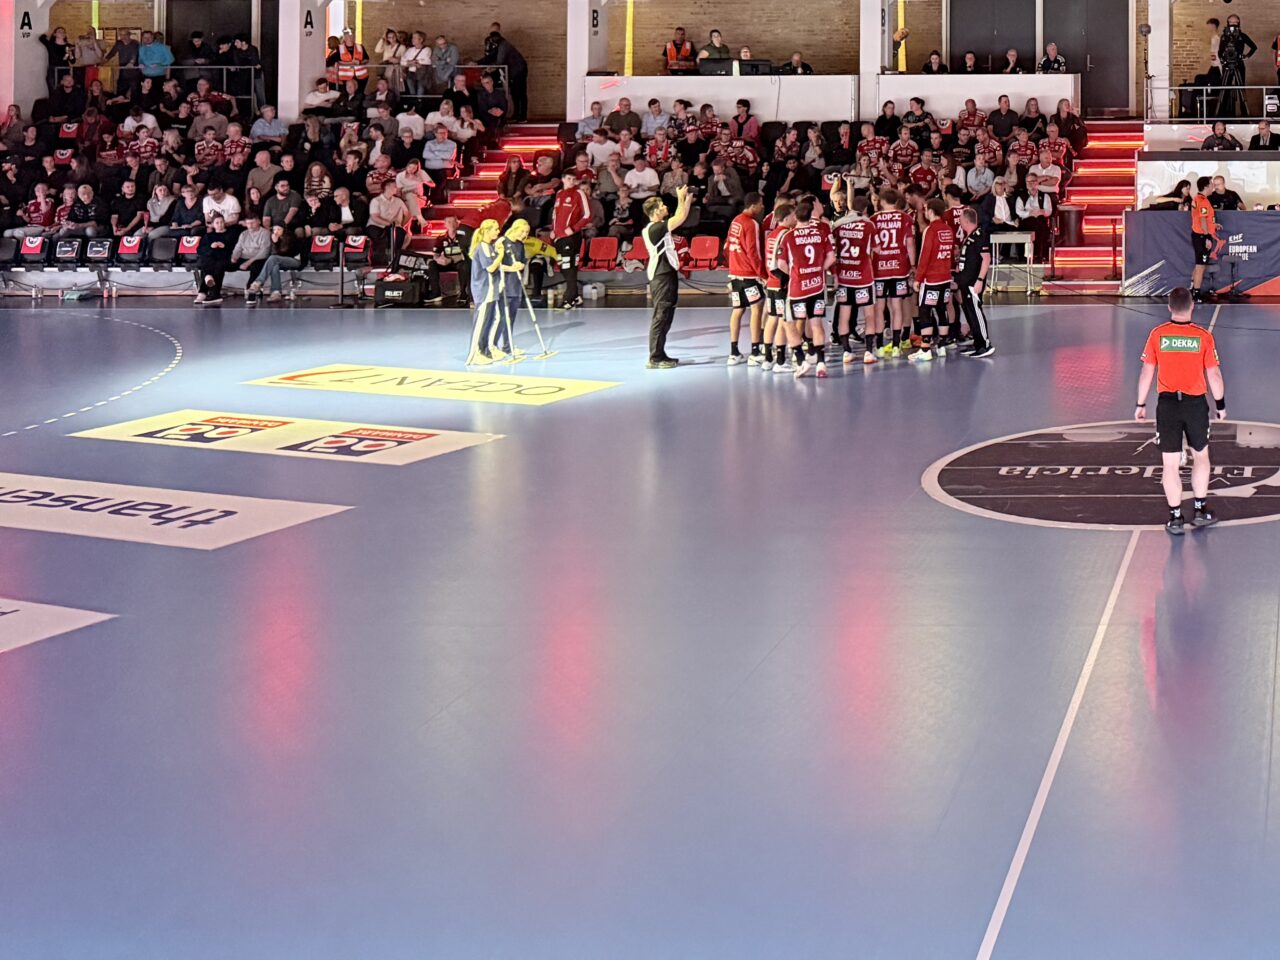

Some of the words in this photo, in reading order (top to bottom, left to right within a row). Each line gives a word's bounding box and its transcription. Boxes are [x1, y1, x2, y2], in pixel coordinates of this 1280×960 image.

[19, 11, 33, 30] A
[304, 9, 314, 29] A
[592, 9, 599, 29] B
[880, 229, 899, 249] 91
[1229, 233, 1243, 242] EHF
[804, 245, 815, 265] 9
[1228, 245, 1258, 253] EUROPEAN
[1171, 338, 1199, 349] DEKRA
